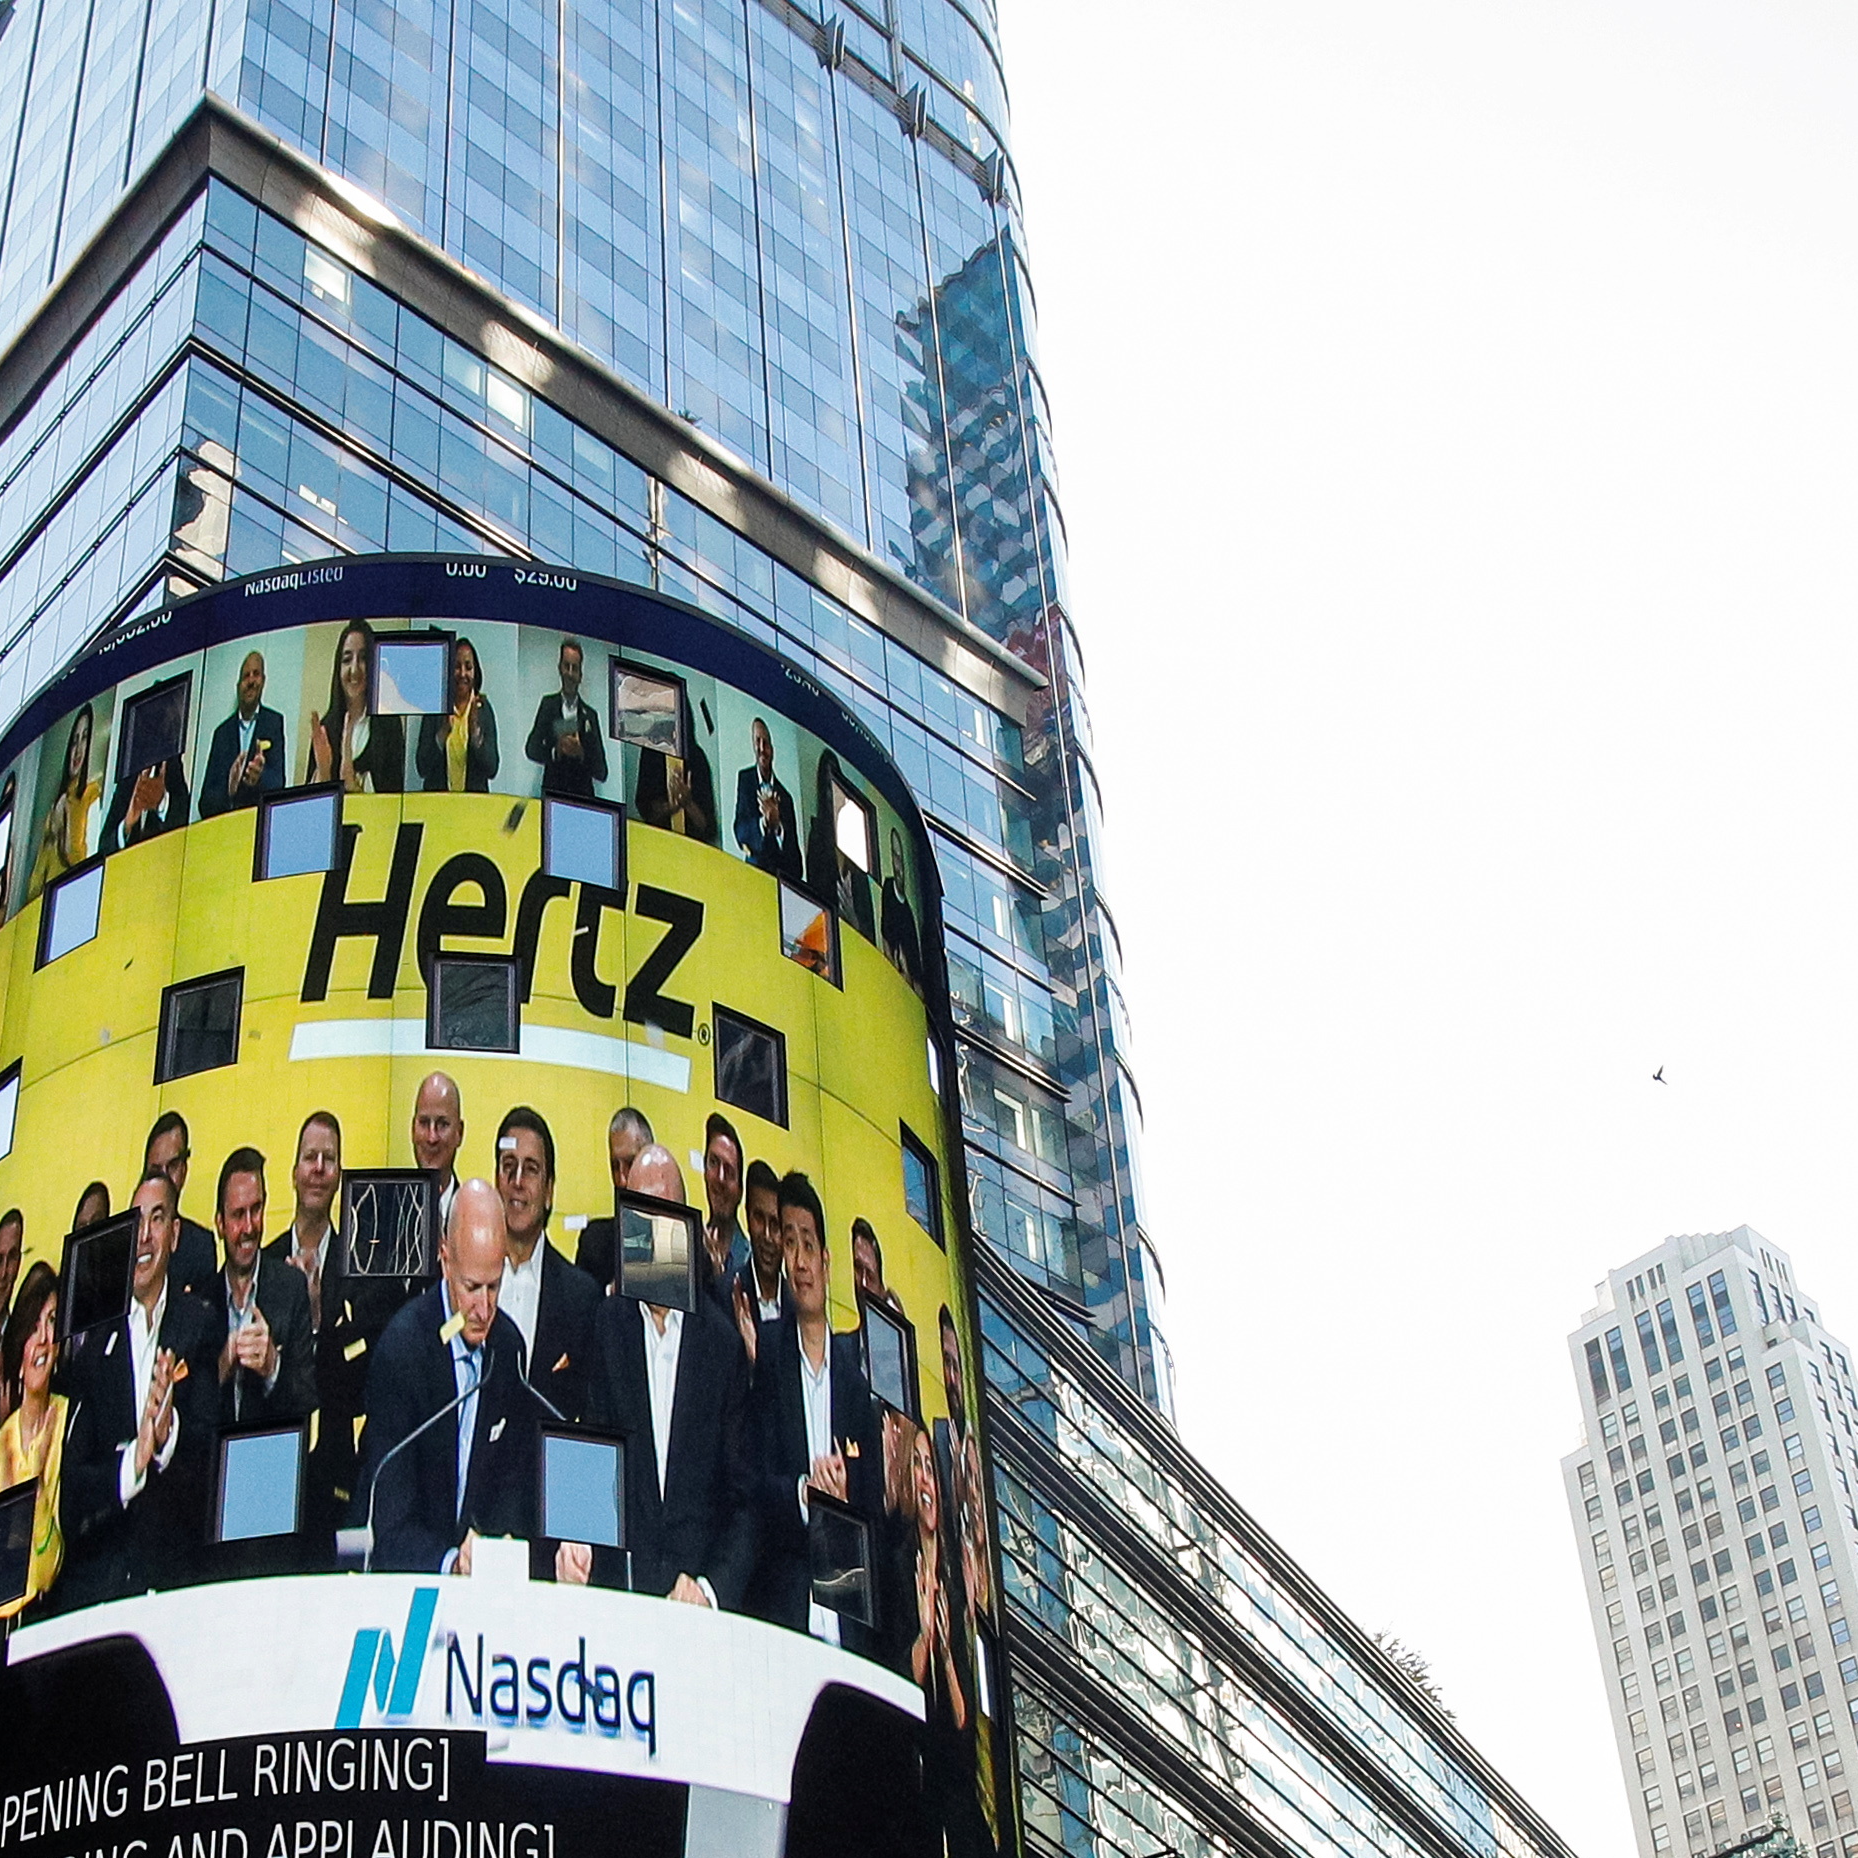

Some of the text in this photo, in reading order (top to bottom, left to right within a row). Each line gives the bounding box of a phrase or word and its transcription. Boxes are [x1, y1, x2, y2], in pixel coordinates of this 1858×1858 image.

[300, 822, 705, 1040] Hertz
[444, 1635, 657, 1756] Nasdaq
[142, 1745, 237, 1812] BELL
[254, 1737, 451, 1802] RINGING]
